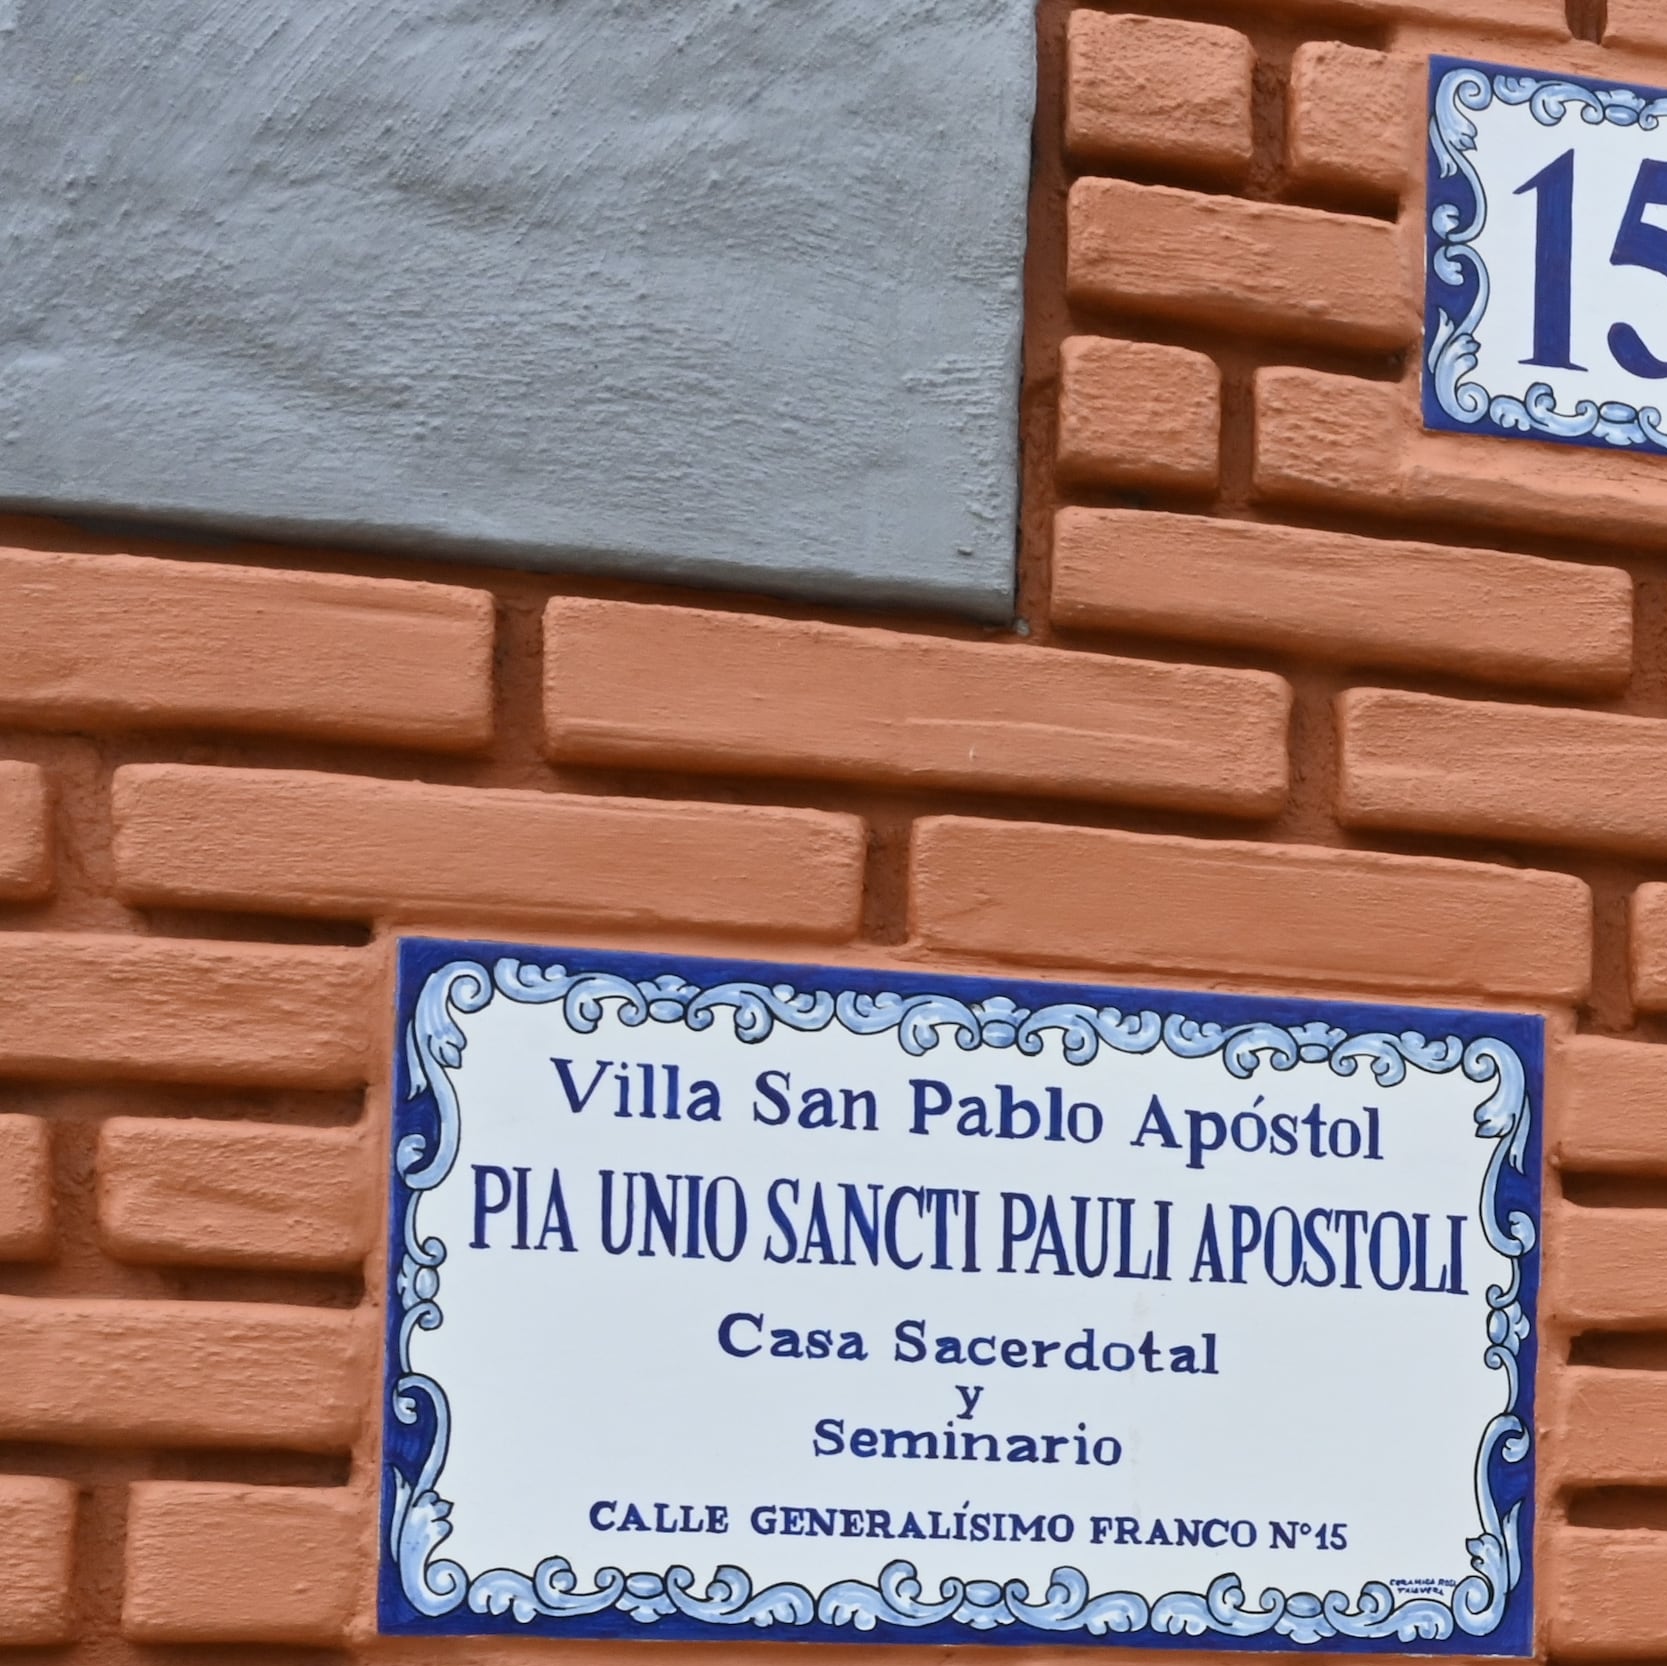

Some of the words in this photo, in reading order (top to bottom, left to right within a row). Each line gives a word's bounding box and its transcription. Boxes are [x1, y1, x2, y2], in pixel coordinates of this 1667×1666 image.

[550, 1056, 722, 1121] Villa
[752, 1069, 879, 1131] San
[909, 1079, 1103, 1143] Pablo
[1130, 1094, 1384, 1170] Apóstol
[468, 1163, 579, 1253] PIA
[598, 1169, 748, 1263] UNIO
[763, 1177, 982, 1274] SANCTI
[996, 1191, 1174, 1281] PAULI
[1188, 1202, 1469, 1297] APOSTOLI
[717, 1312, 869, 1363] Casa
[895, 1319, 1220, 1375] Sacerdotal
[954, 1384, 985, 1421] y
[812, 1418, 1122, 1467] Seminario
[588, 1500, 729, 1536] CALLE
[750, 1500, 1075, 1543] GENERALÍSIMO
[1089, 1516, 1258, 1549] FRANCO
